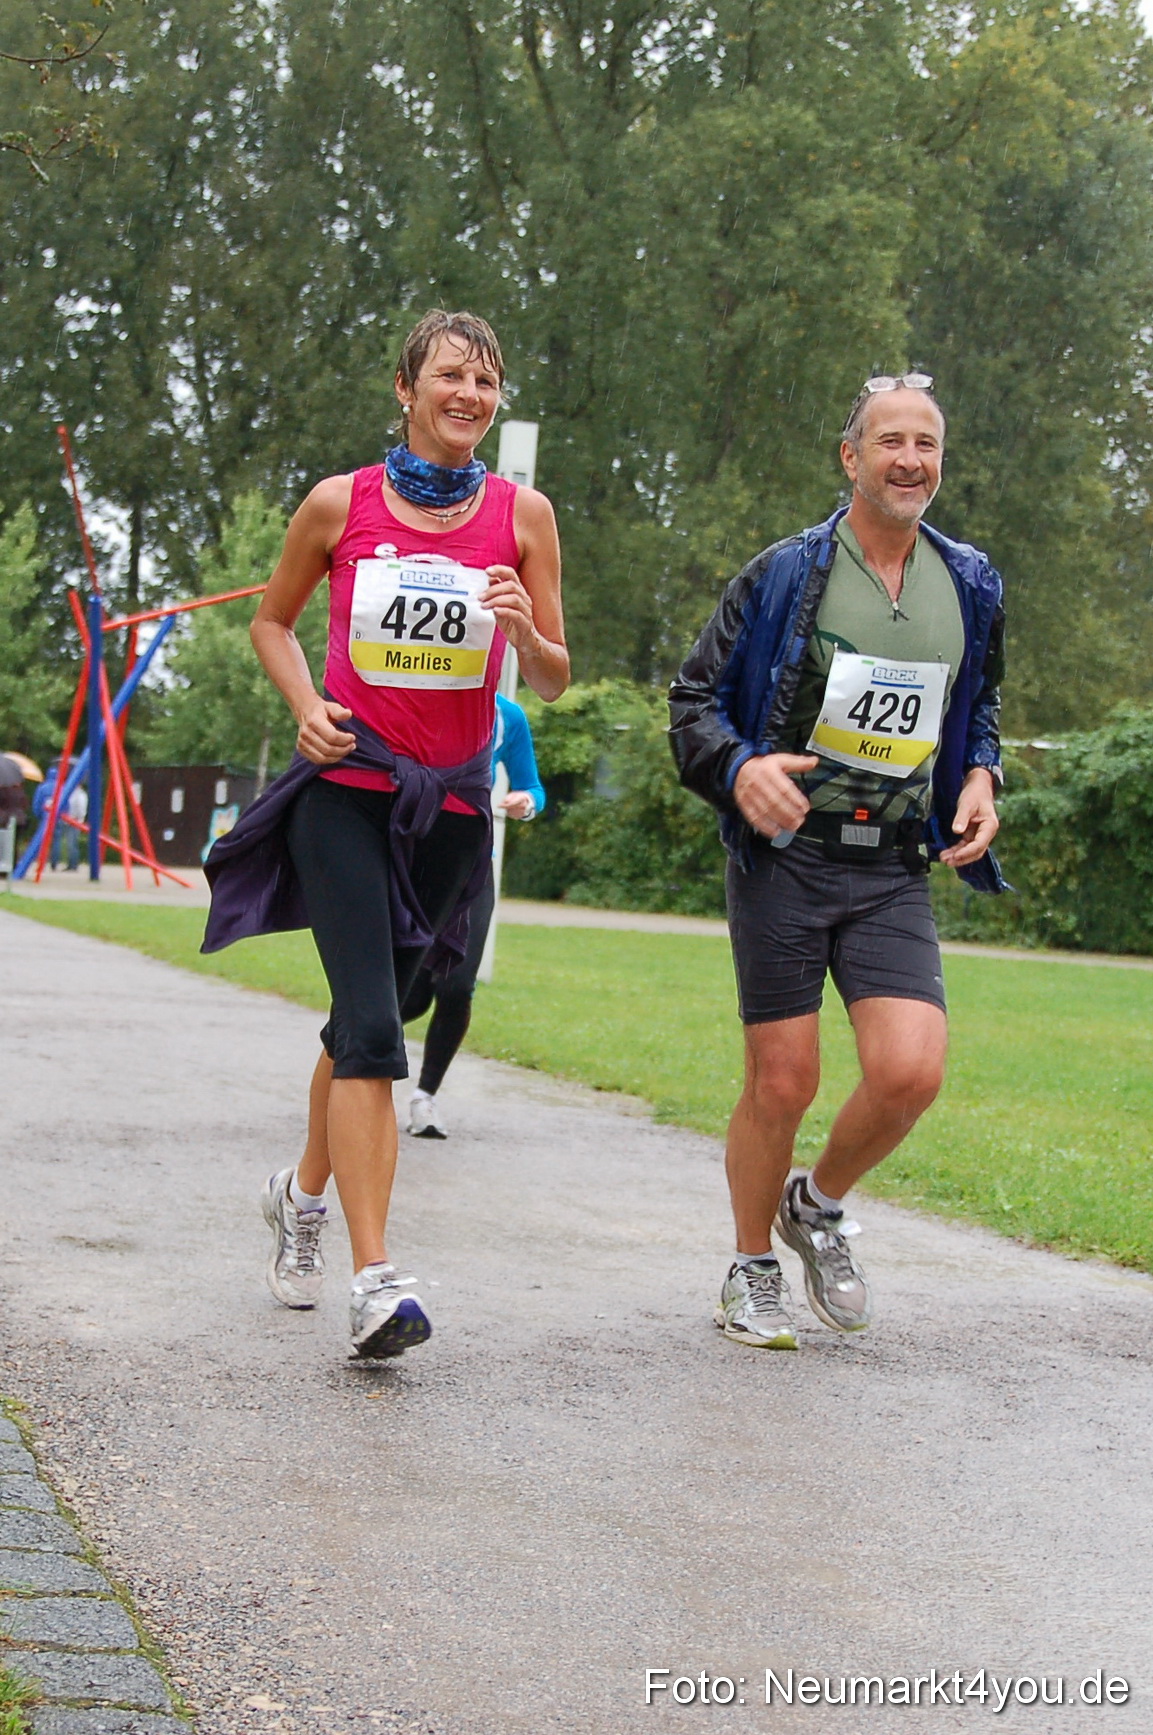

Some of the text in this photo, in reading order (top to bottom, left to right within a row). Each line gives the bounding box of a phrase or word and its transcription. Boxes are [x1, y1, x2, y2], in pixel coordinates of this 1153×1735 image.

[400, 570, 455, 586] BOCK
[380, 595, 467, 645] 428
[384, 650, 452, 671] Marlies
[872, 667, 918, 681] BOCK
[847, 690, 922, 735] 429
[858, 739, 892, 759] Kurt
